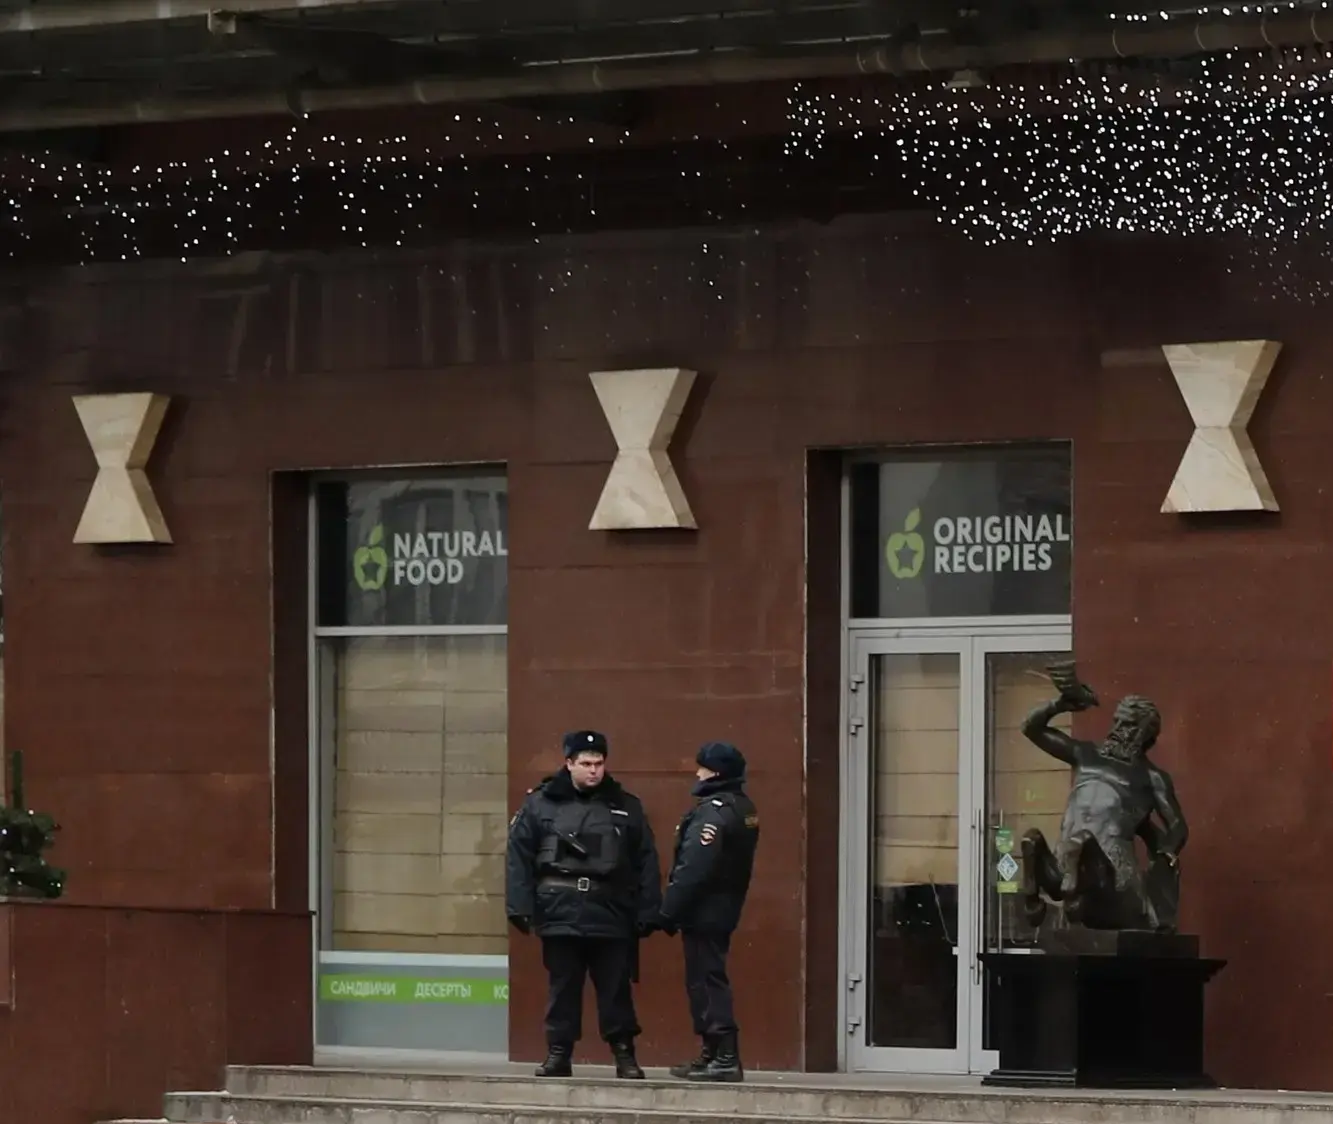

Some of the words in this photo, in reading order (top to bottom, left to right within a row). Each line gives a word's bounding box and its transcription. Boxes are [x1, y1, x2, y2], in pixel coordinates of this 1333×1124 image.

[934, 514, 1070, 545] ORIGINAL
[394, 530, 508, 558] NATURAL
[934, 543, 1052, 573] RECIPIES
[394, 559, 464, 585] FOOD
[330, 980, 397, 998] САНДВИЧИ
[414, 982, 472, 999] ДЕСЕРТЫ
